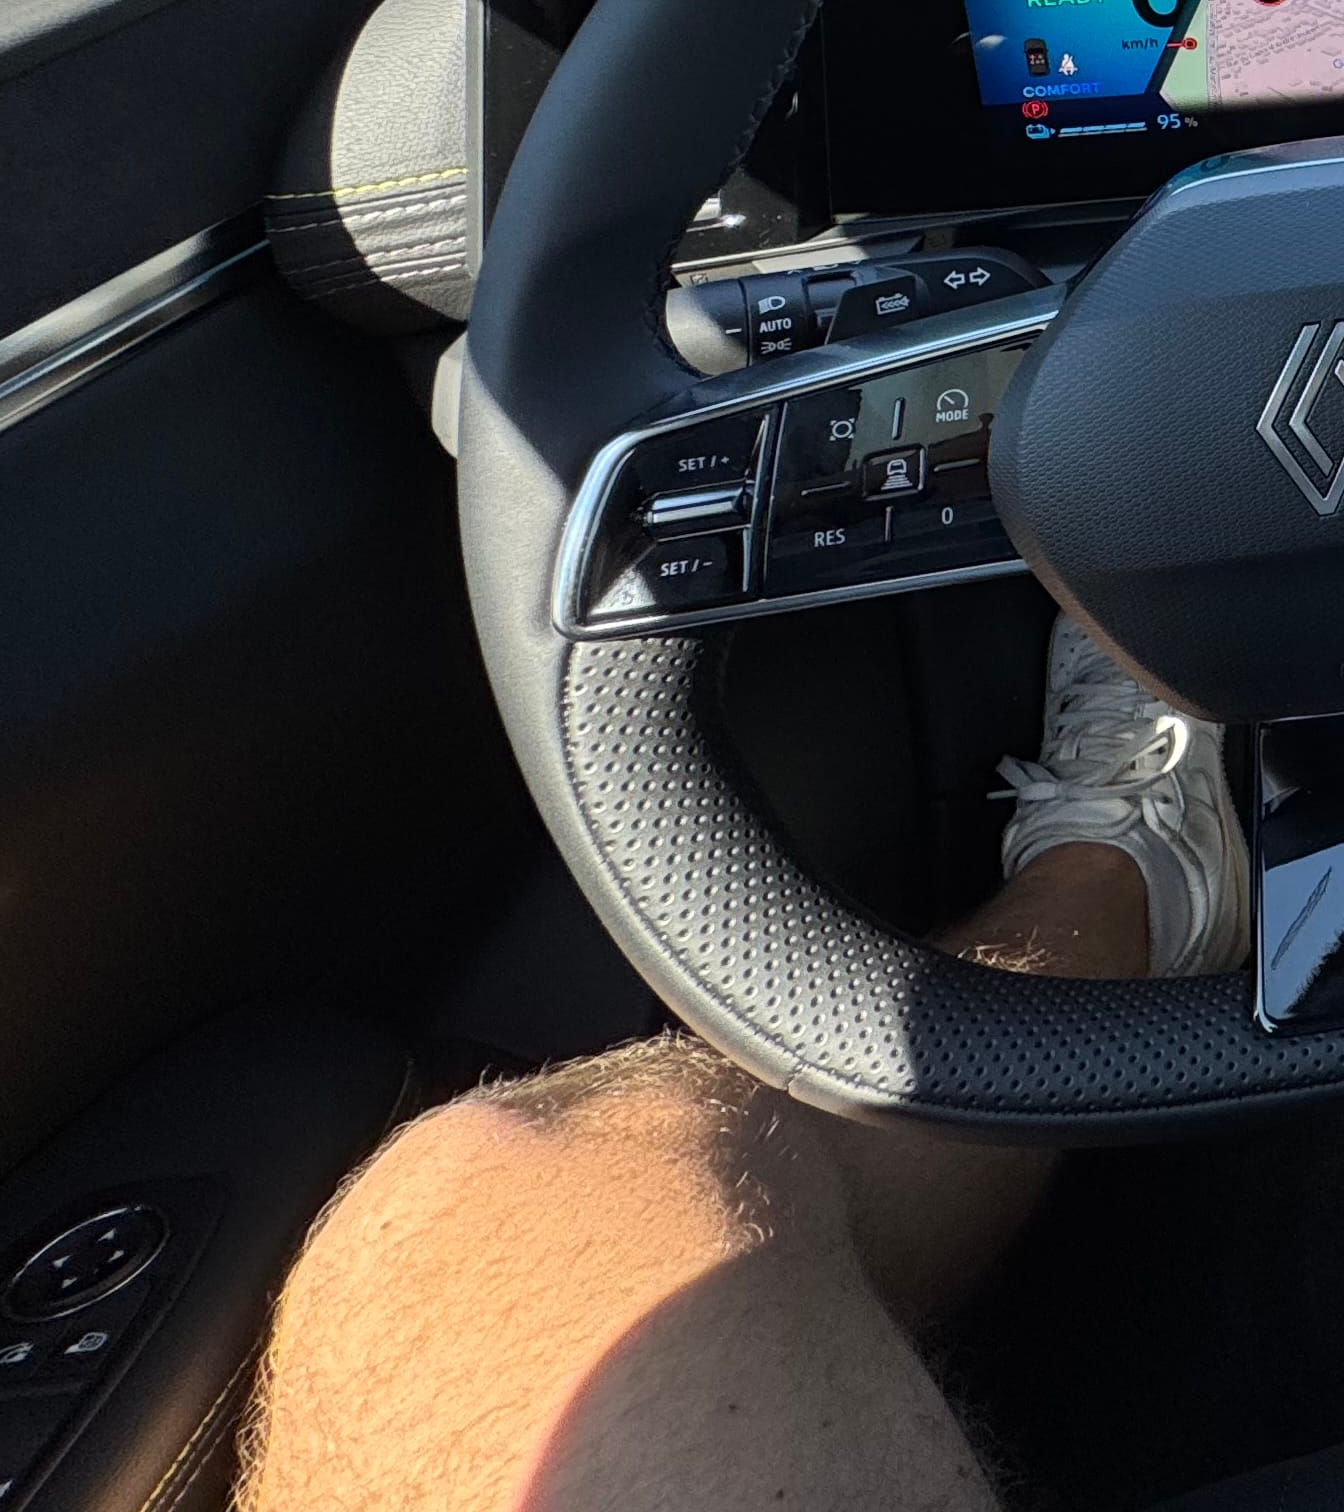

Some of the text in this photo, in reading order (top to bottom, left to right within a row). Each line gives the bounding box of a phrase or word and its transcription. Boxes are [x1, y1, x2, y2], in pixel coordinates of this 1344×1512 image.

[1121, 37, 1159, 52] km/h
[1023, 82, 1101, 98] COMFORT
[1157, 113, 1182, 130] 95
[758, 317, 792, 334] AUTO
[935, 407, 969, 423] MODE
[678, 456, 706, 473] SET
[813, 529, 846, 548] RES
[660, 560, 688, 578] SET
